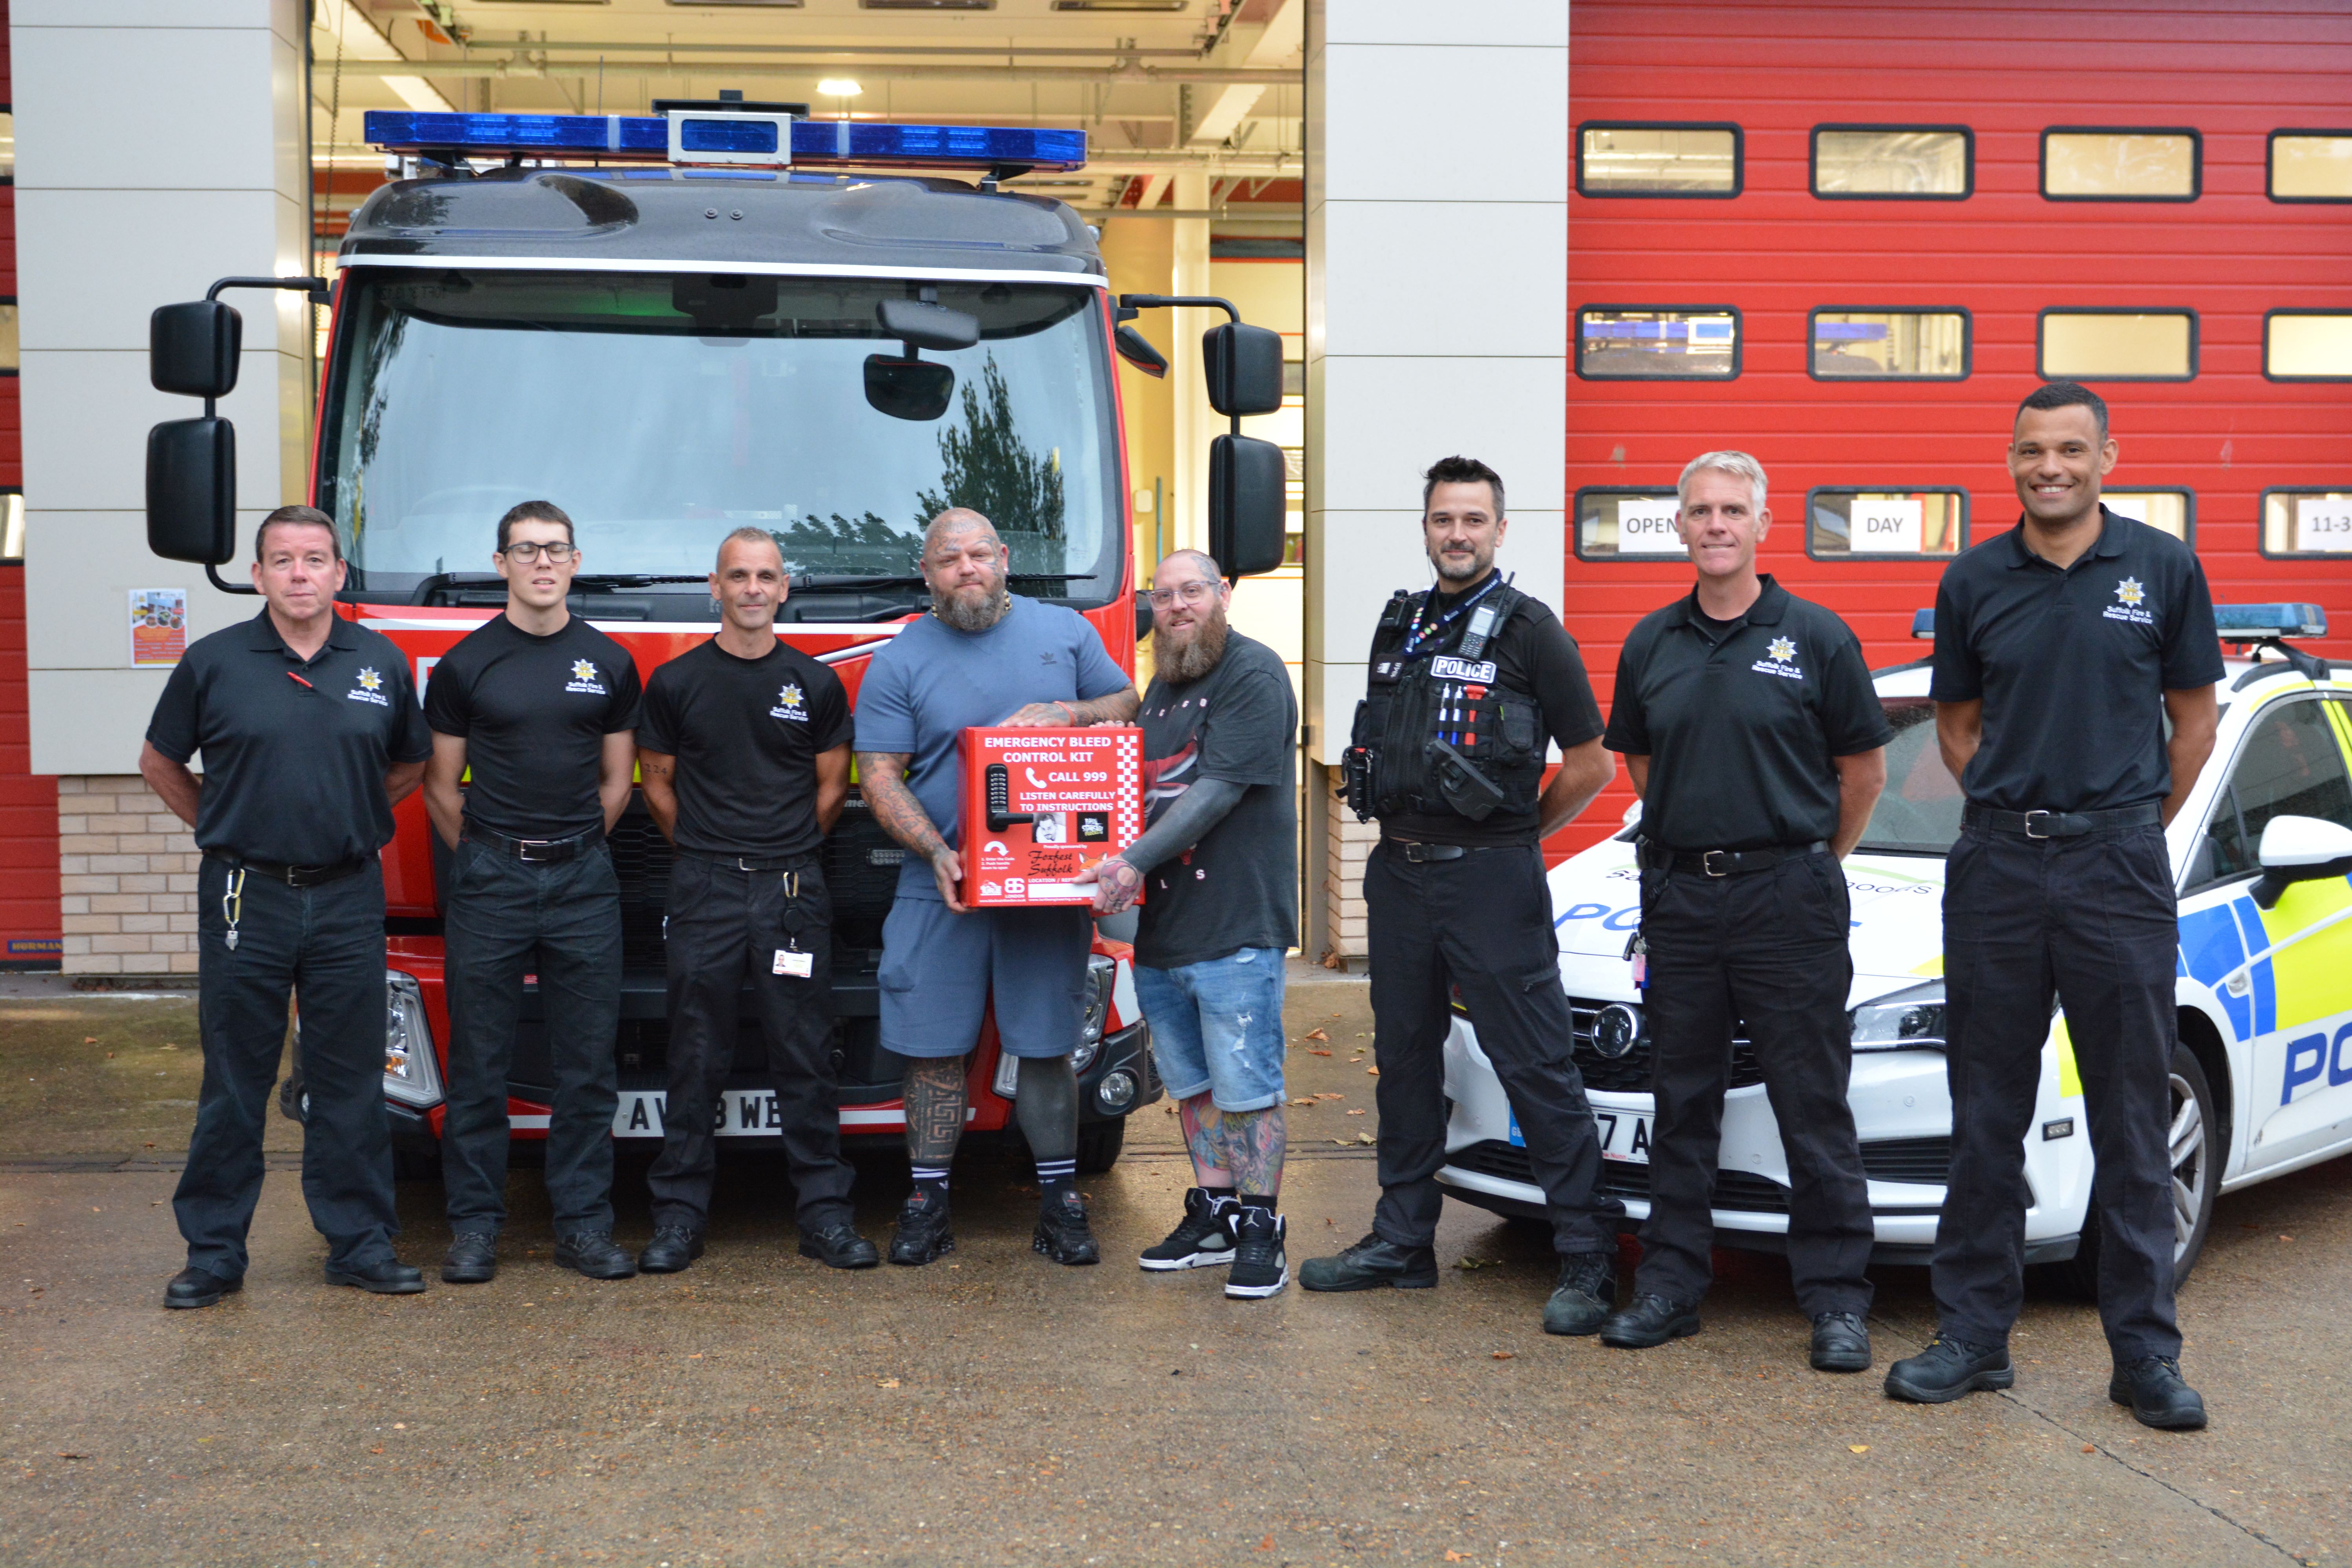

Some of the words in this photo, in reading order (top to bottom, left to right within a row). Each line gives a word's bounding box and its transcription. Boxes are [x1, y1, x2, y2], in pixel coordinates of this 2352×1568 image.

[1626, 517, 1677, 534] OPEN
[1867, 517, 1904, 534] DAY
[2107, 606, 2131, 615] Suffolk
[2103, 611, 2128, 620] Rescue
[2129, 615, 2153, 624] Service
[1436, 659, 1491, 679] POLICE
[1751, 664, 1777, 674] Rescue
[1777, 670, 1803, 679] Service
[1756, 661, 1780, 670] Suffolk
[984, 737, 1066, 748] EMERGENCY
[1069, 737, 1111, 747] BLEED
[1003, 752, 1066, 762] CONTROL
[1070, 752, 1094, 762] KIT
[1048, 772, 1080, 782] CALL
[1083, 772, 1107, 782] 999
[1059, 791, 1116, 800] CAREFULLY
[1036, 803, 1114, 811] INSTRUCTIONS
[1028, 850, 1073, 864] Foxfest
[1027, 863, 1073, 877] Suffolk
